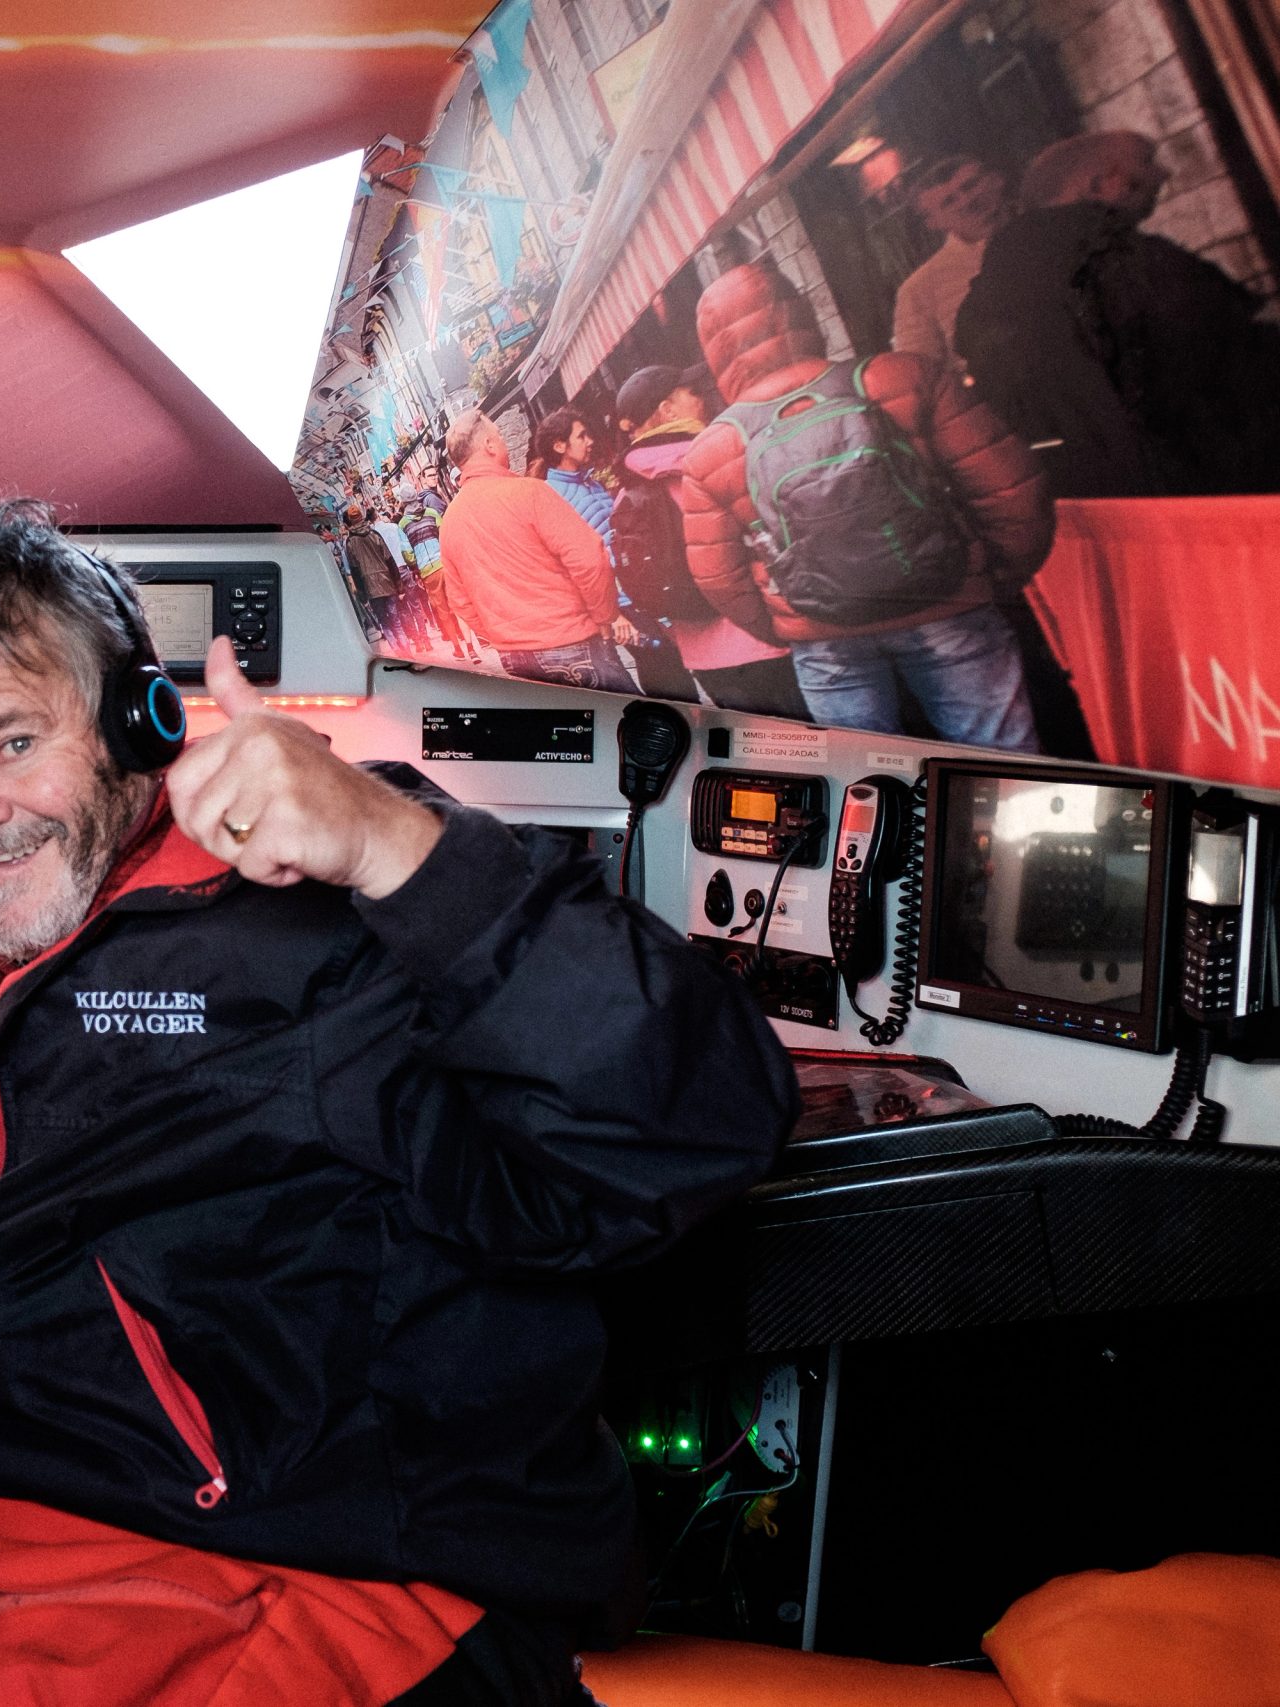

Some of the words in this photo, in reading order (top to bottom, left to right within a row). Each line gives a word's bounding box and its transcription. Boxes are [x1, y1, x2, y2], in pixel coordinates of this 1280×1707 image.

[534, 752, 582, 761] ACTIV'ECHO
[742, 746, 787, 756] CALLSIGN
[74, 991, 207, 1011] KILCULLEN
[791, 1006, 814, 1019] SOCKETS
[81, 1013, 207, 1034] VOYAGER
